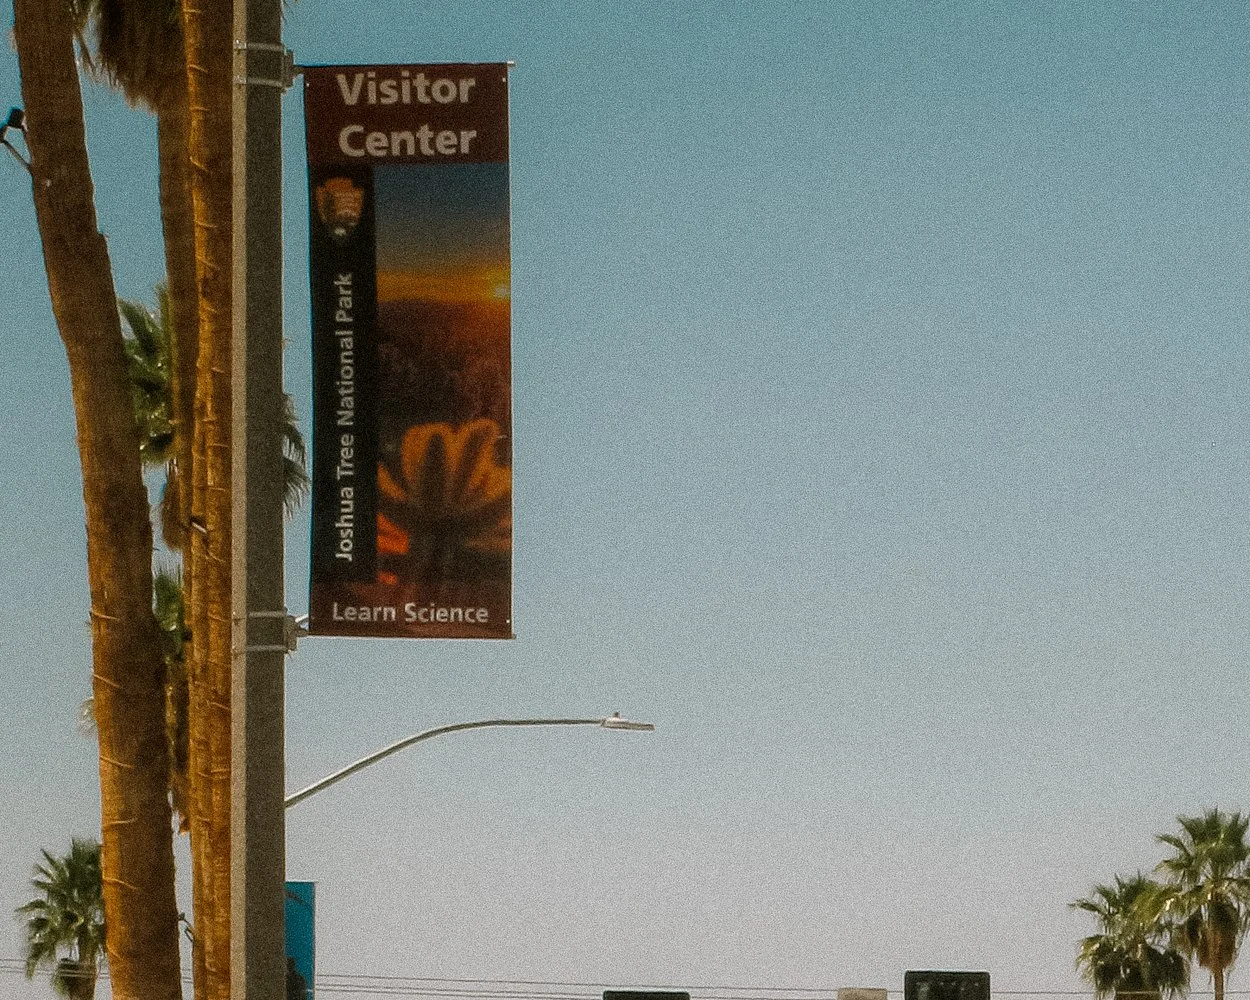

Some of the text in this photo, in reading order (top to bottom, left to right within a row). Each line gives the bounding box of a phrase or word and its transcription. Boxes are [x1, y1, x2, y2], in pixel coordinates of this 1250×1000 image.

[336, 70, 476, 106] Visitor
[338, 124, 477, 157] Center
[333, 272, 354, 562] Joshua Tree National Park
[333, 602, 489, 623] Learn Science
